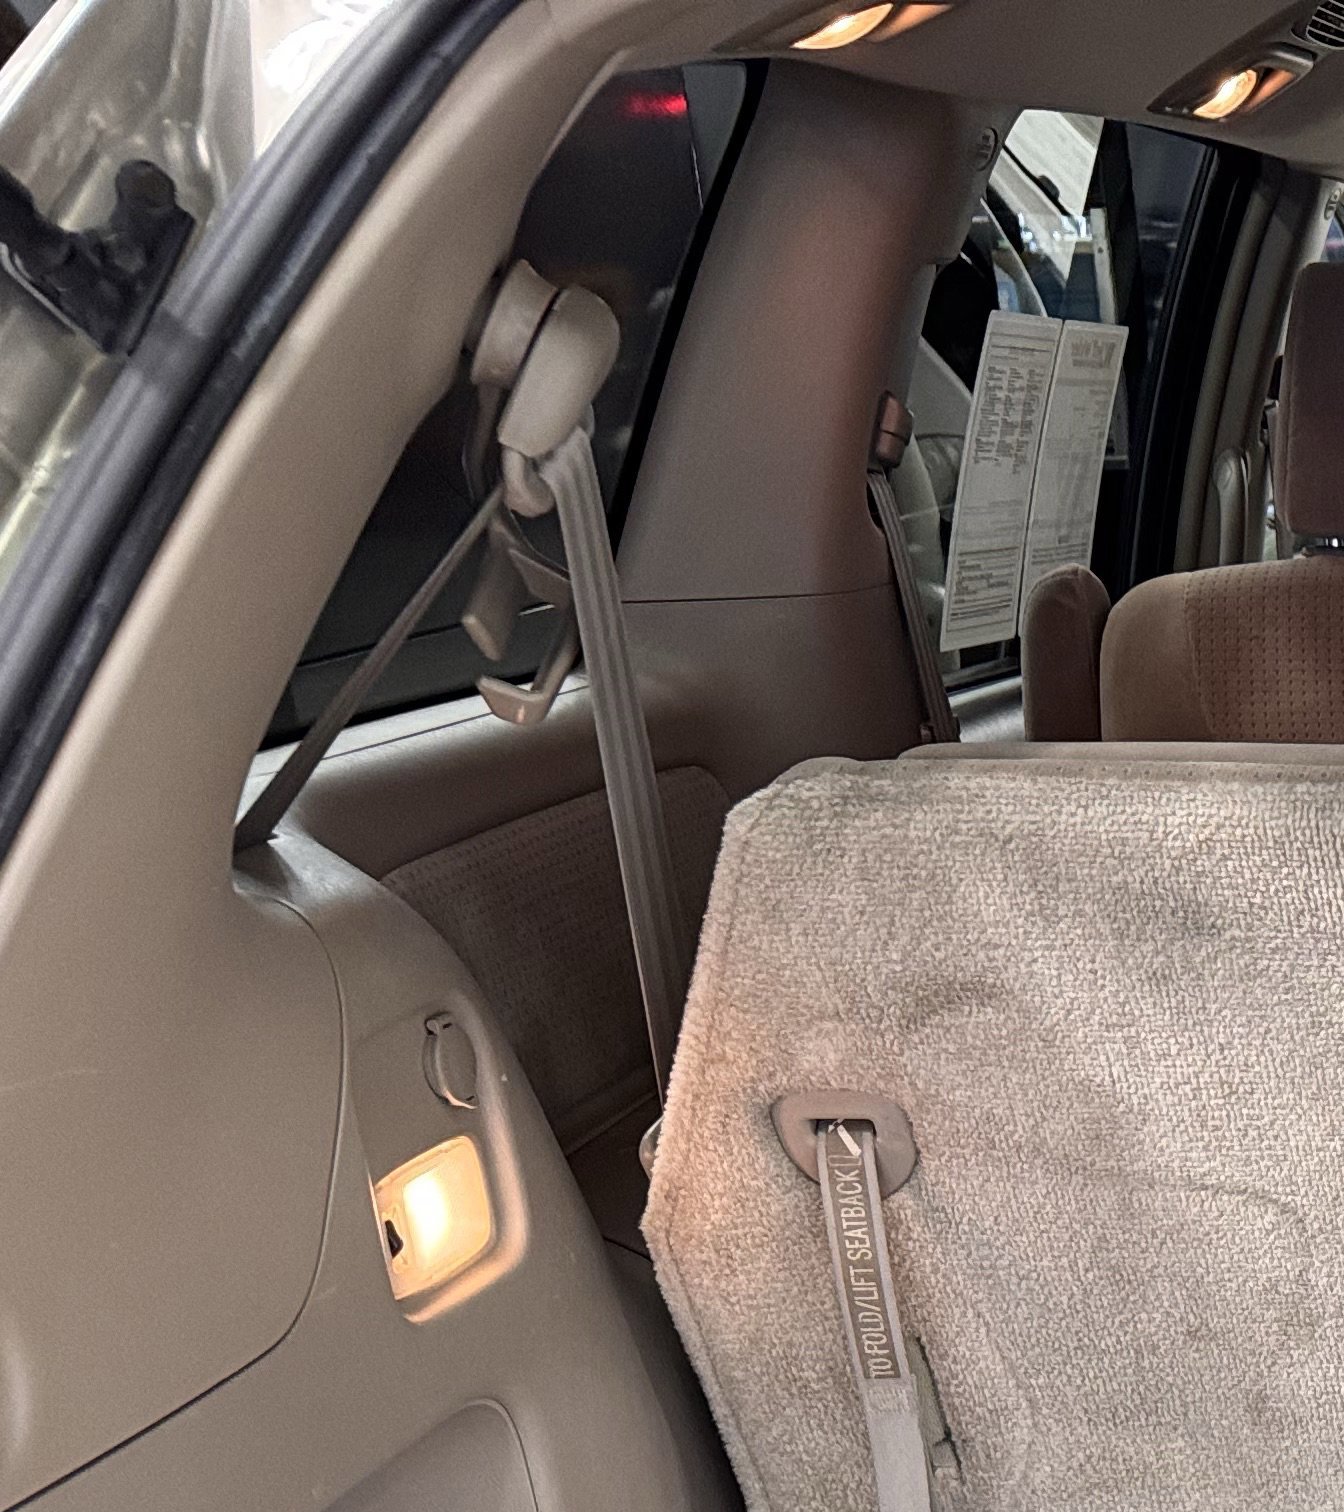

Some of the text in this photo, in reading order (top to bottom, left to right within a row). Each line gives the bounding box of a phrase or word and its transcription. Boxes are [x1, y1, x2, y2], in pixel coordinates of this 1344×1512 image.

[835, 1167, 895, 1379] TO FOLD/LIFT SEATBACK
